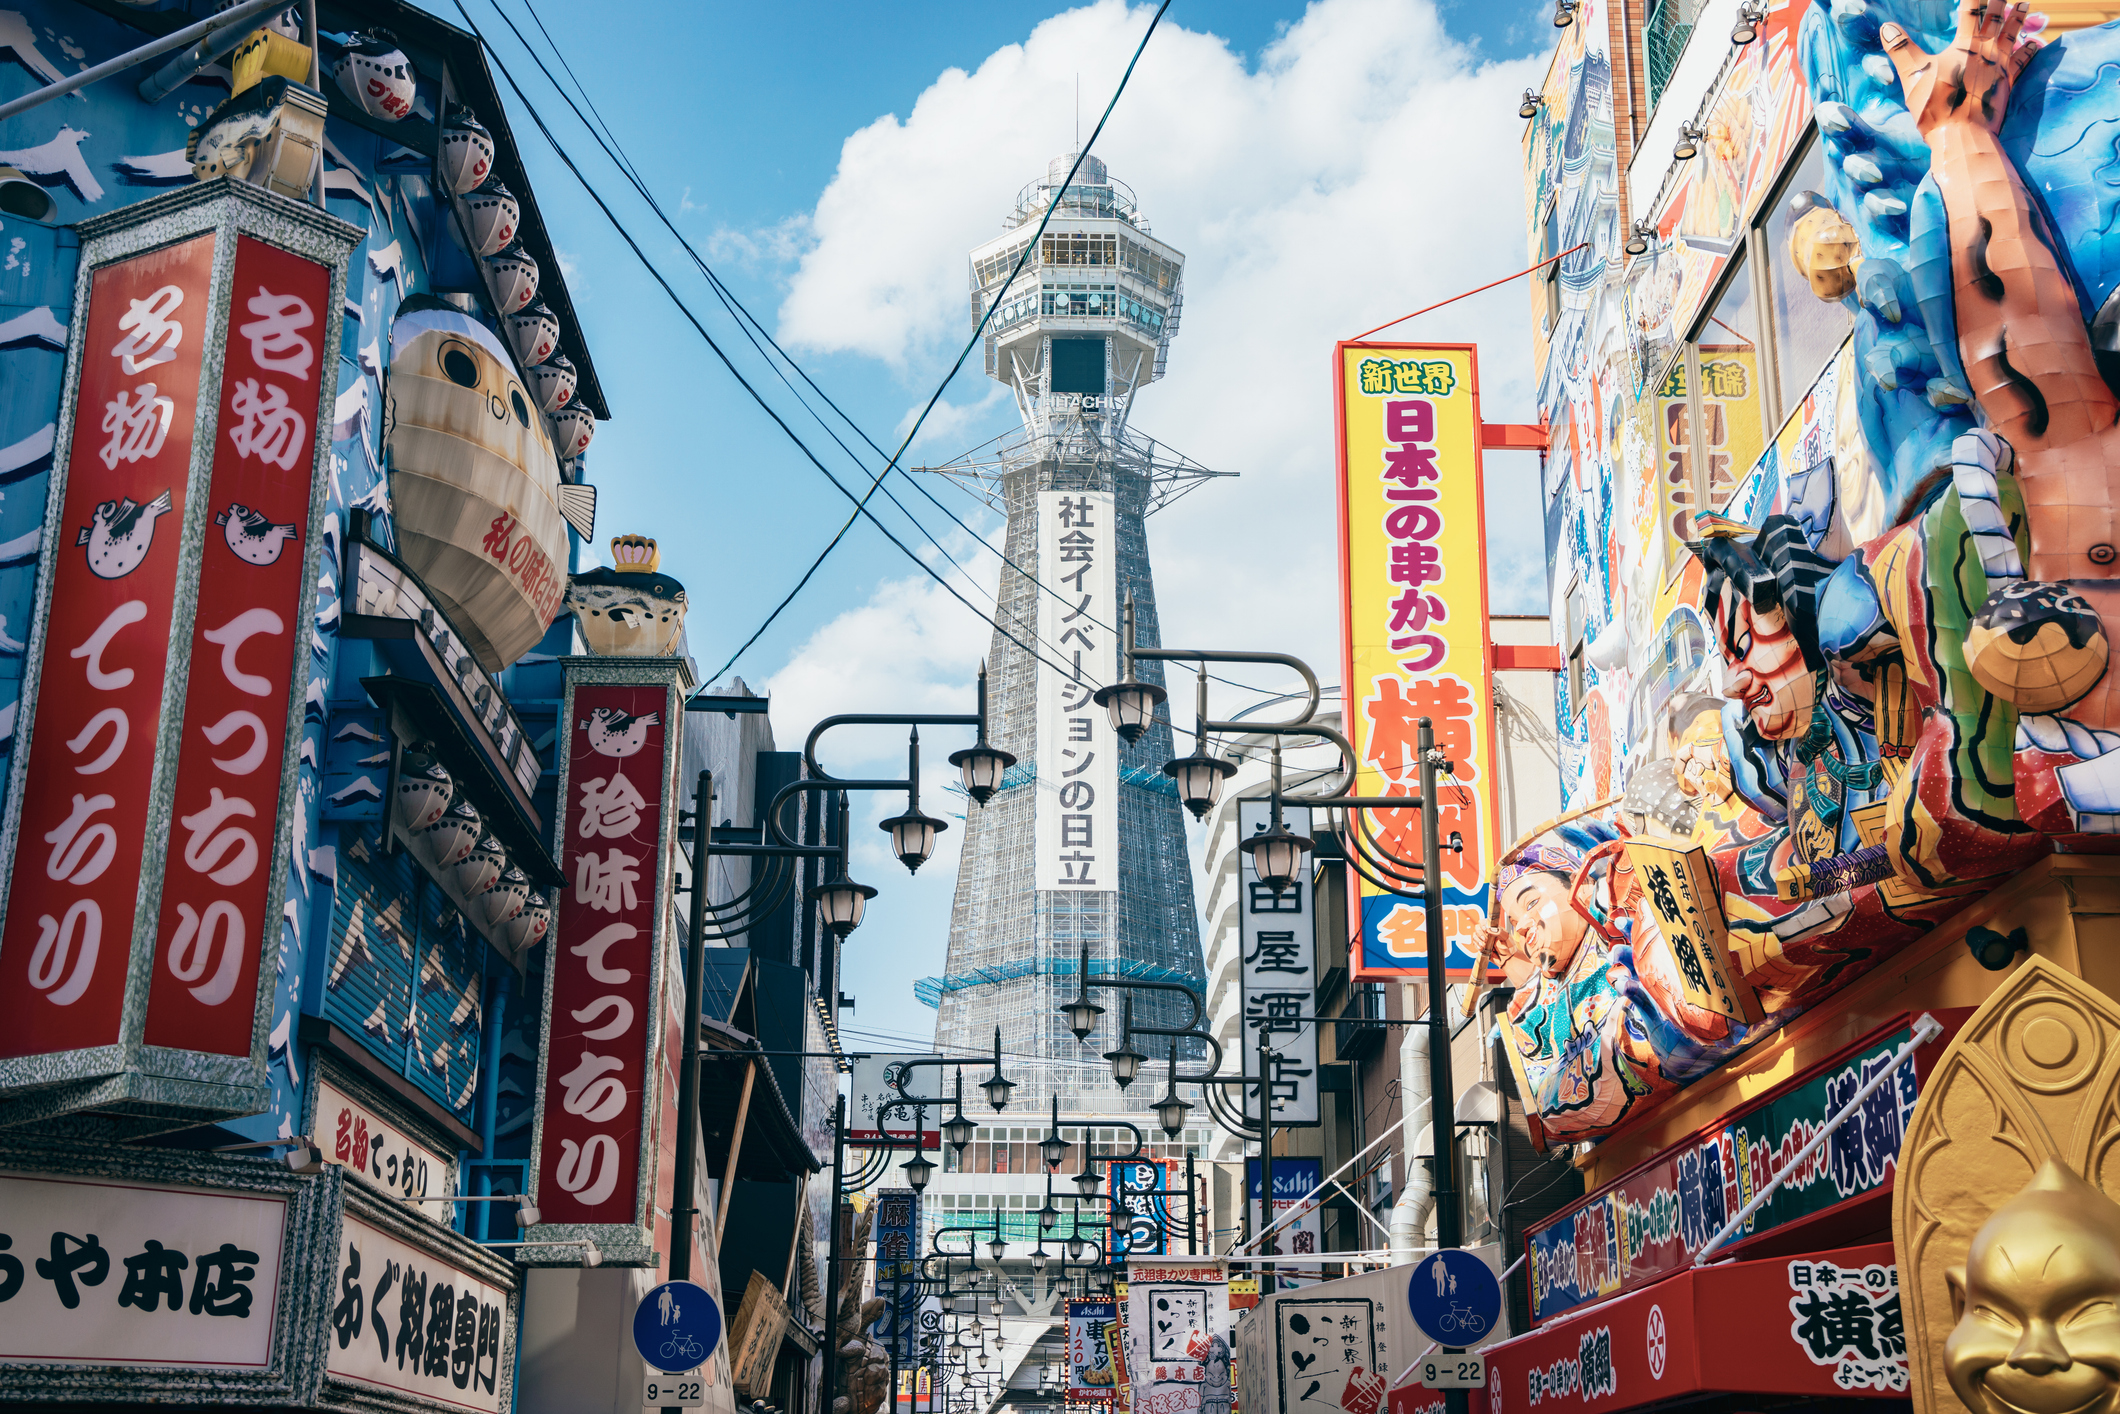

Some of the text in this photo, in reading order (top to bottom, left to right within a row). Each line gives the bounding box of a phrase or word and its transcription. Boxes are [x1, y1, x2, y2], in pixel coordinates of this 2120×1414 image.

[1042, 396, 1113, 409] HITACHI
[1361, 361, 1455, 394] 新世界
[1384, 400, 1446, 671] 日本一の串かつ
[1058, 495, 1096, 886] 社会イノベーションの日立
[1367, 677, 1478, 891] 横綱
[1245, 822, 1312, 1103] 田屋酒店
[1643, 863, 1712, 996] 横綱
[1826, 1050, 1902, 1195] 横綱
[879, 1197, 911, 1259] 麻雀
[1678, 1139, 1726, 1251] 横綱
[1133, 1268, 1223, 1281] 元祖串カツ専門店
[1574, 1201, 1608, 1298] 横綱
[332, 1241, 500, 1396] ふぐ料理専門
[1081, 1305, 1105, 1316] Asahi
[1085, 1319, 1110, 1371] 串カツ
[1339, 1314, 1363, 1365] 新世界
[1375, 1301, 1389, 1373] 商標登録
[1528, 1357, 1579, 1407] 日本一の串かつ
[1579, 1326, 1611, 1402] 横綱
